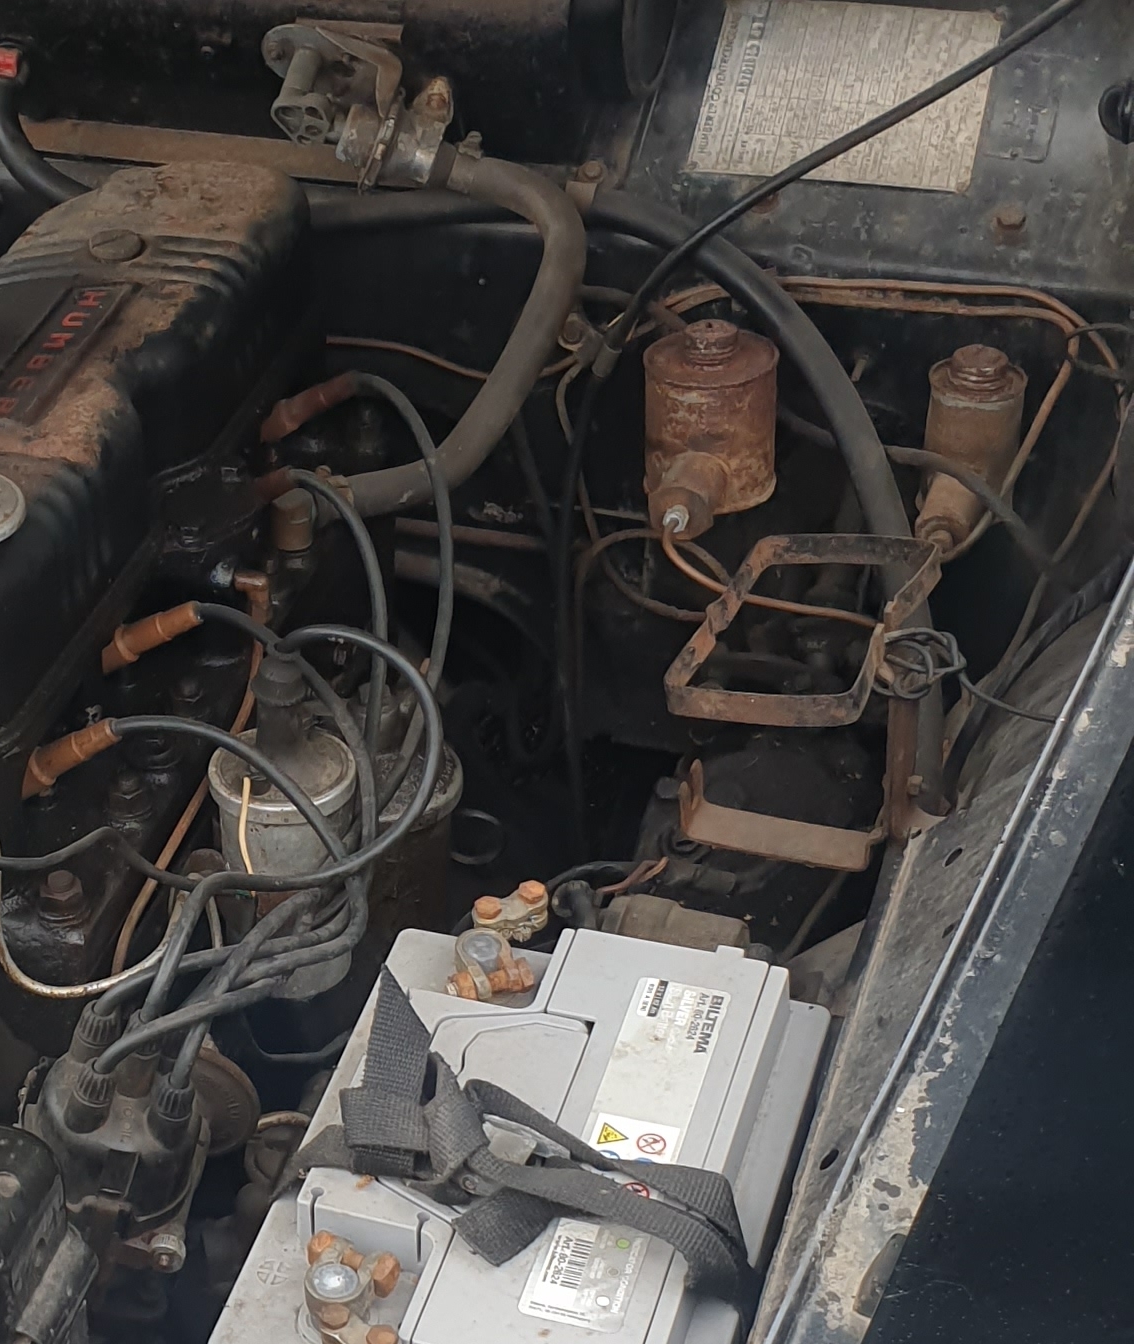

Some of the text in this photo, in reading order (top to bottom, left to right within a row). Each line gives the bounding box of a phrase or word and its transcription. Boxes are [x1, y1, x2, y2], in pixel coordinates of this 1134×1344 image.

[697, 116, 714, 154] HUMBER
[674, 989, 697, 1027] SILVER
[693, 993, 725, 1054] BILTEMA
